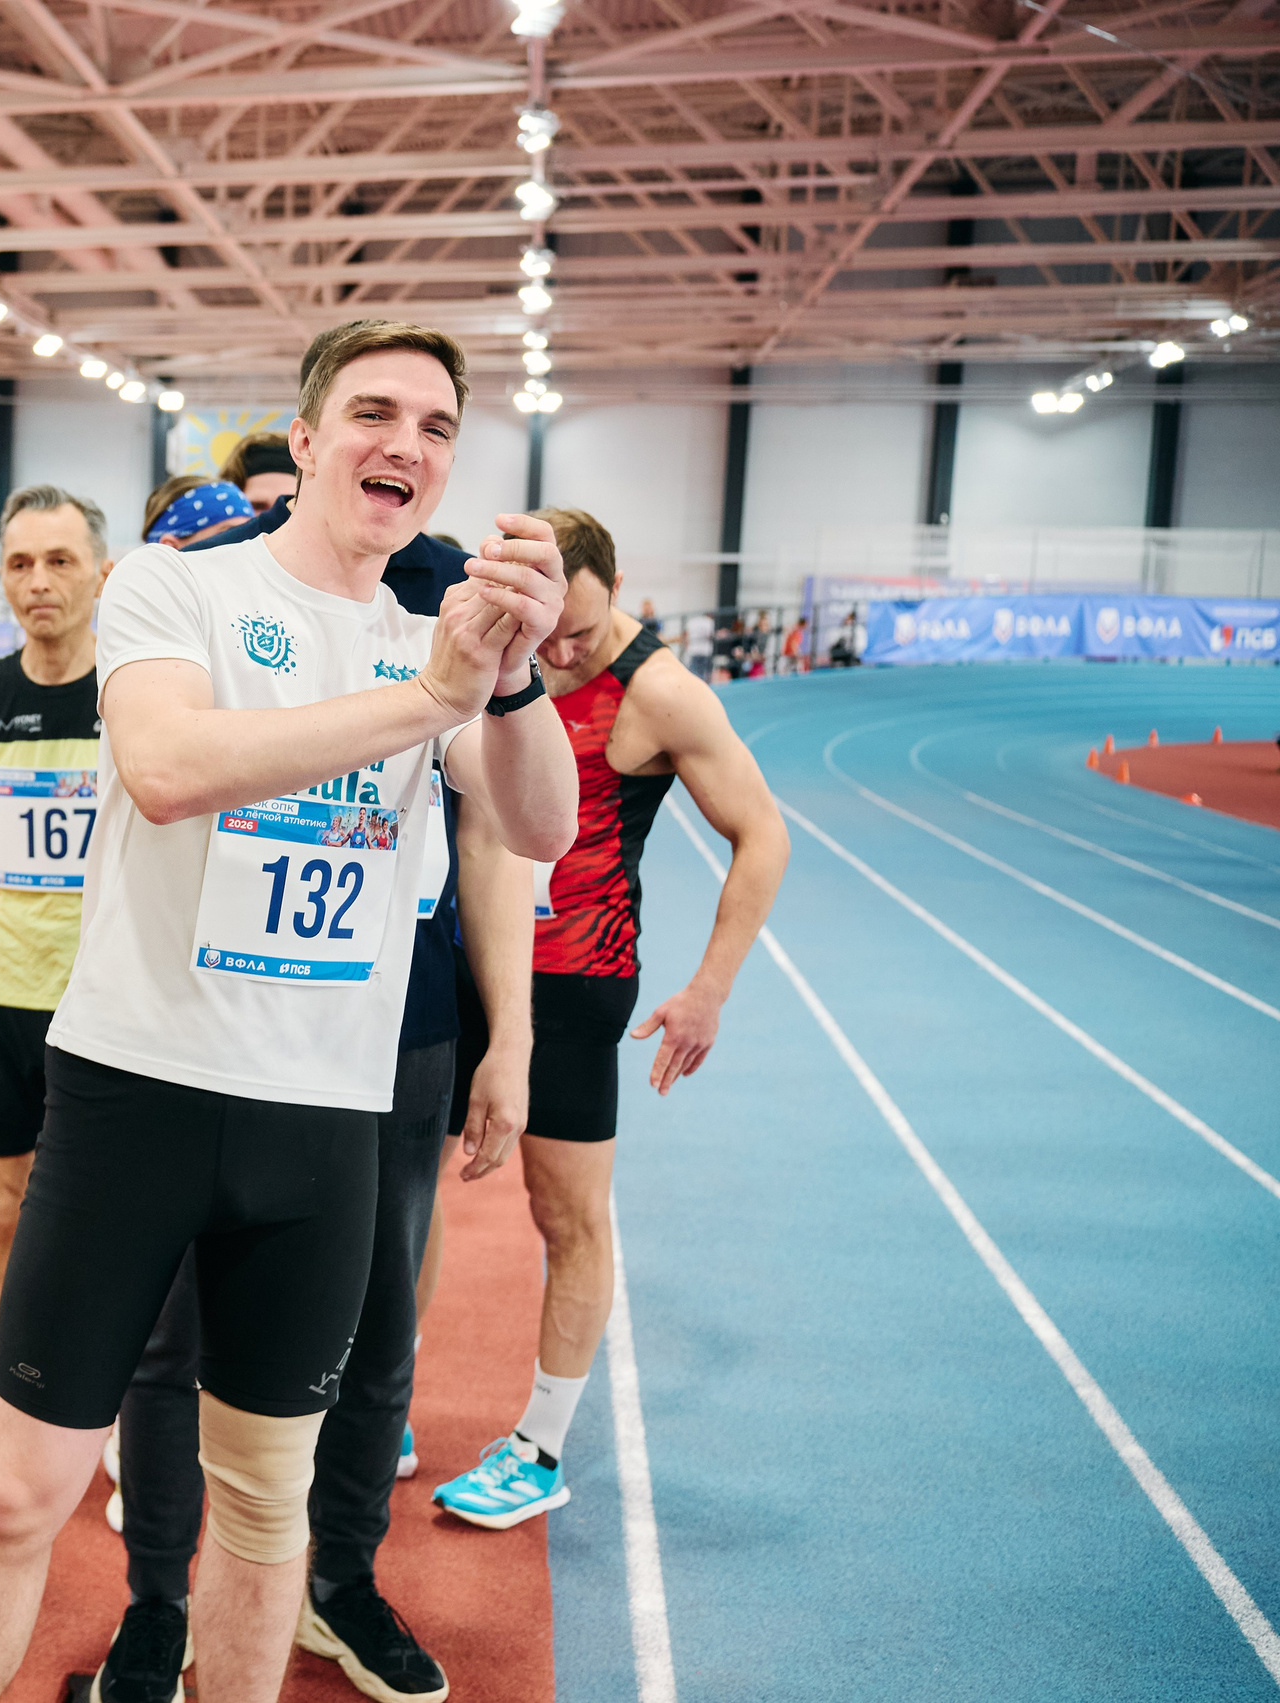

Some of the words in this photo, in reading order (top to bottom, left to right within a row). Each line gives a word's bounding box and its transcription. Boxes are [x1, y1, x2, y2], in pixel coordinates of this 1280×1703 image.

[1123, 616, 1183, 638] ВФЛА
[271, 802, 295, 813] ОПК
[228, 818, 254, 830] 2026
[230, 809, 243, 817] по
[245, 810, 281, 822] лёгкой
[284, 815, 327, 828] атлетике
[20, 808, 97, 859] 167
[261, 855, 365, 939] 132
[225, 956, 266, 972] ВФЛА
[290, 964, 311, 976] ПСБ
